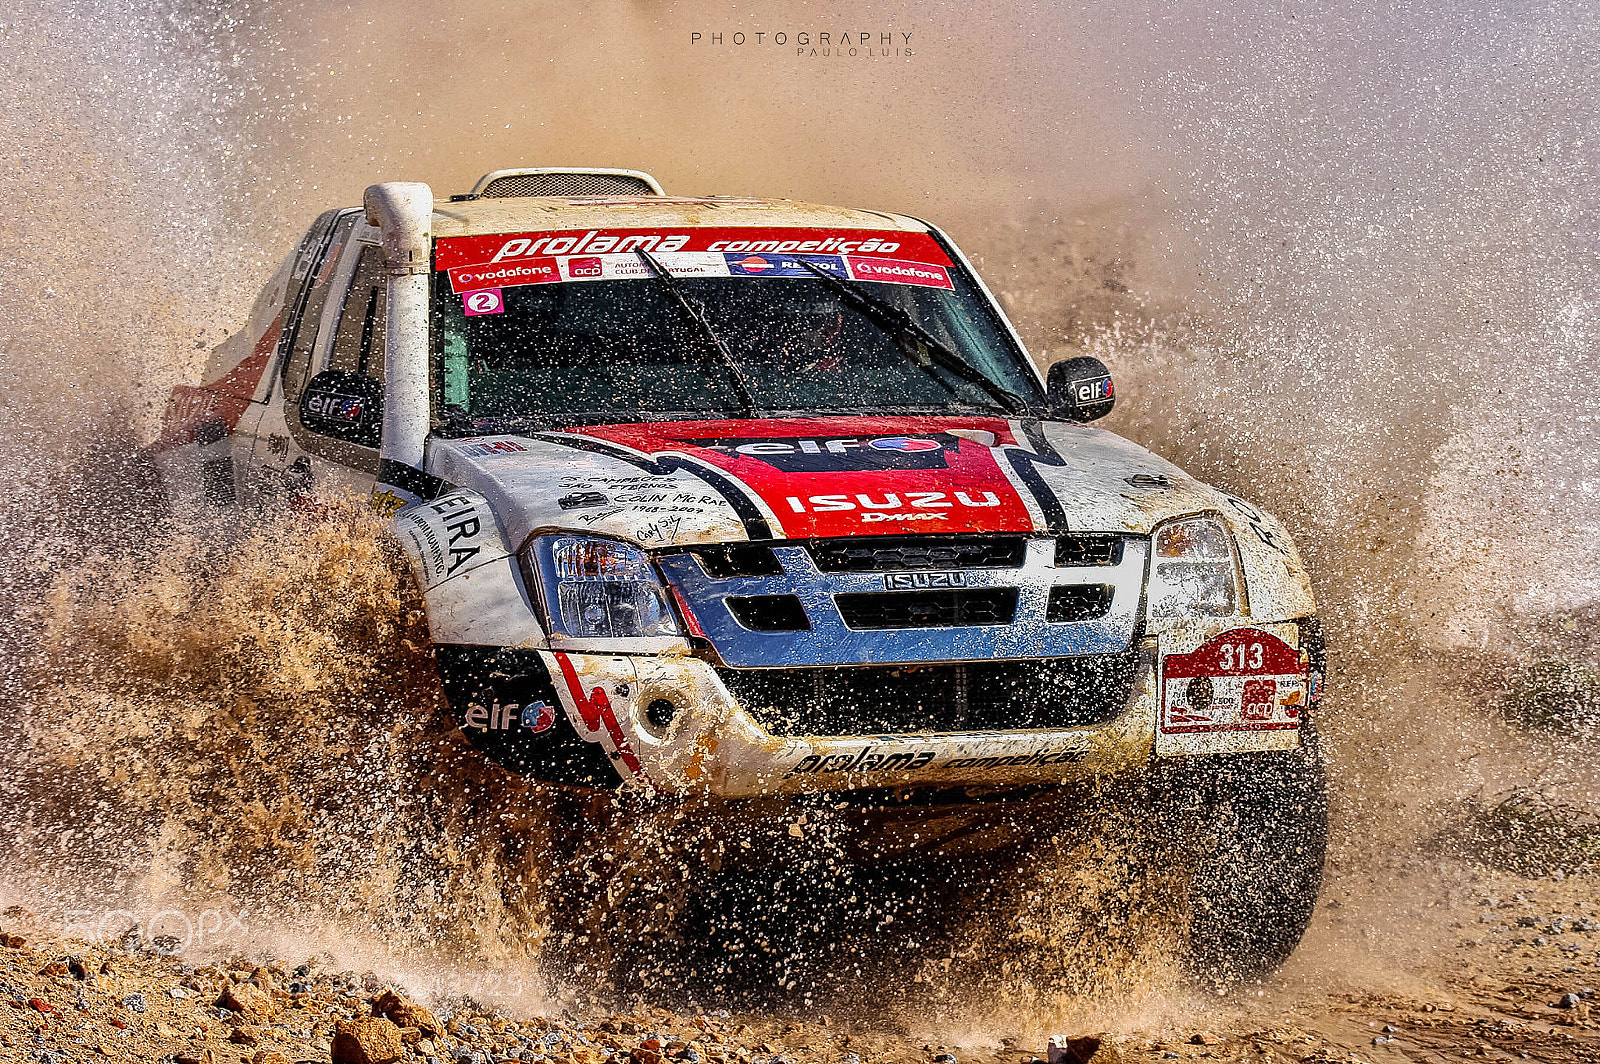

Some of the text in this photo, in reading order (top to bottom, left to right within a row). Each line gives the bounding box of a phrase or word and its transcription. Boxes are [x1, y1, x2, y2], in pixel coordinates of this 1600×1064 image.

[490, 230, 900, 263] prolama competição
[475, 265, 552, 280] vodafone
[574, 266, 601, 277] acp
[615, 261, 670, 269] AUTOMEL
[781, 261, 839, 271] REOL
[870, 265, 945, 281] vodafone
[475, 292, 493, 310] 2
[1078, 381, 1103, 400] elf
[308, 396, 341, 415] elf
[735, 438, 861, 455] elf
[786, 491, 1001, 513] ISUZU
[887, 572, 967, 589] ISUZU
[1219, 643, 1264, 670] 313
[465, 703, 520, 729] elf
[782, 746, 937, 779] prolama
